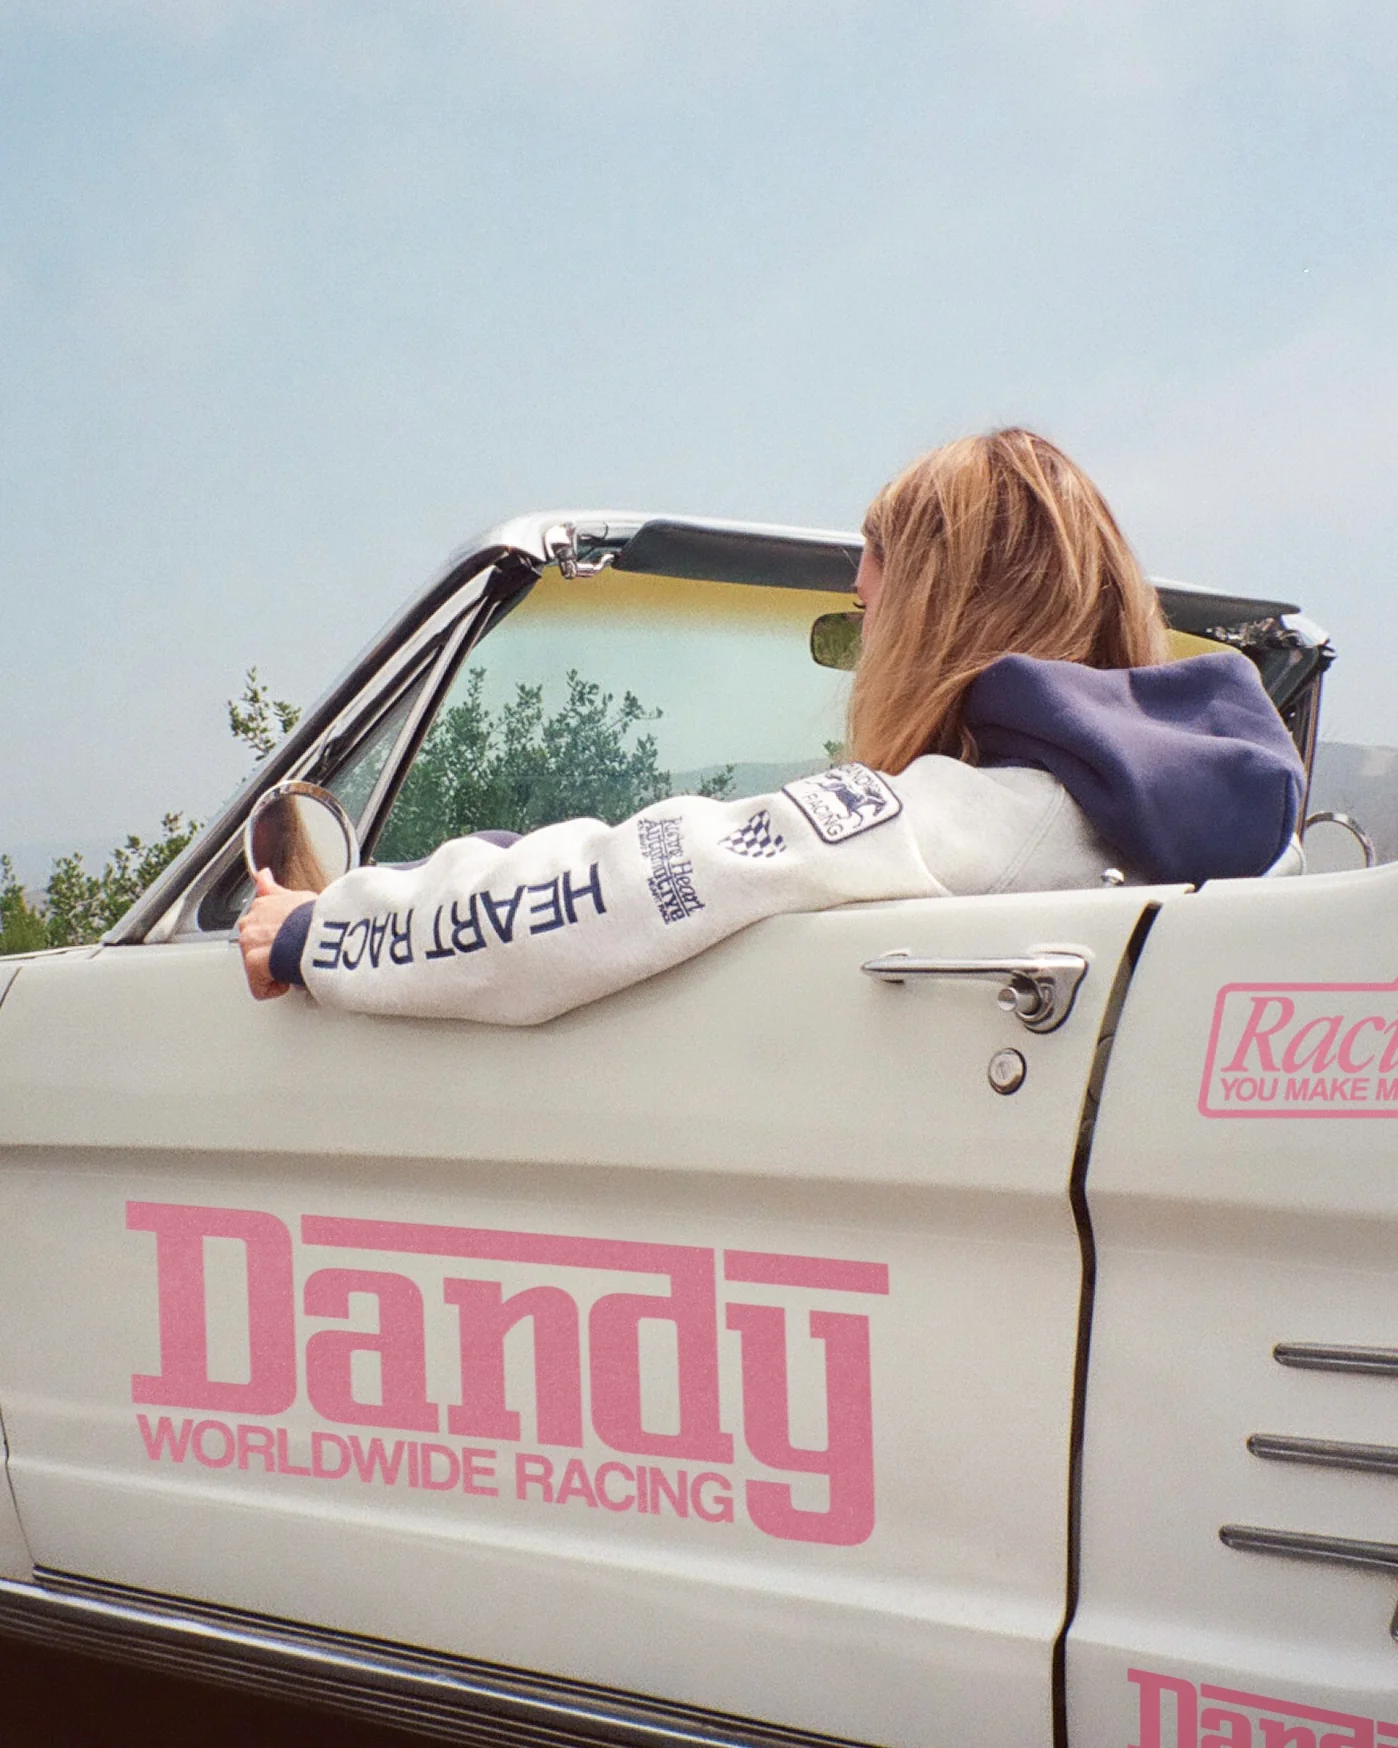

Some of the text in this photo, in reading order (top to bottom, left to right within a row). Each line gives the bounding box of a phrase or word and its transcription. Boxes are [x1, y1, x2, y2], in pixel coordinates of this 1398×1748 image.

[312, 862, 606, 970] HEART RACE
[671, 861, 705, 912] Heart
[1220, 1077, 1279, 1103] YOU
[1284, 1077, 1371, 1102] MAKE
[126, 1201, 890, 1547] Dandy
[136, 1414, 735, 1524] WORLDWIDE RACING
